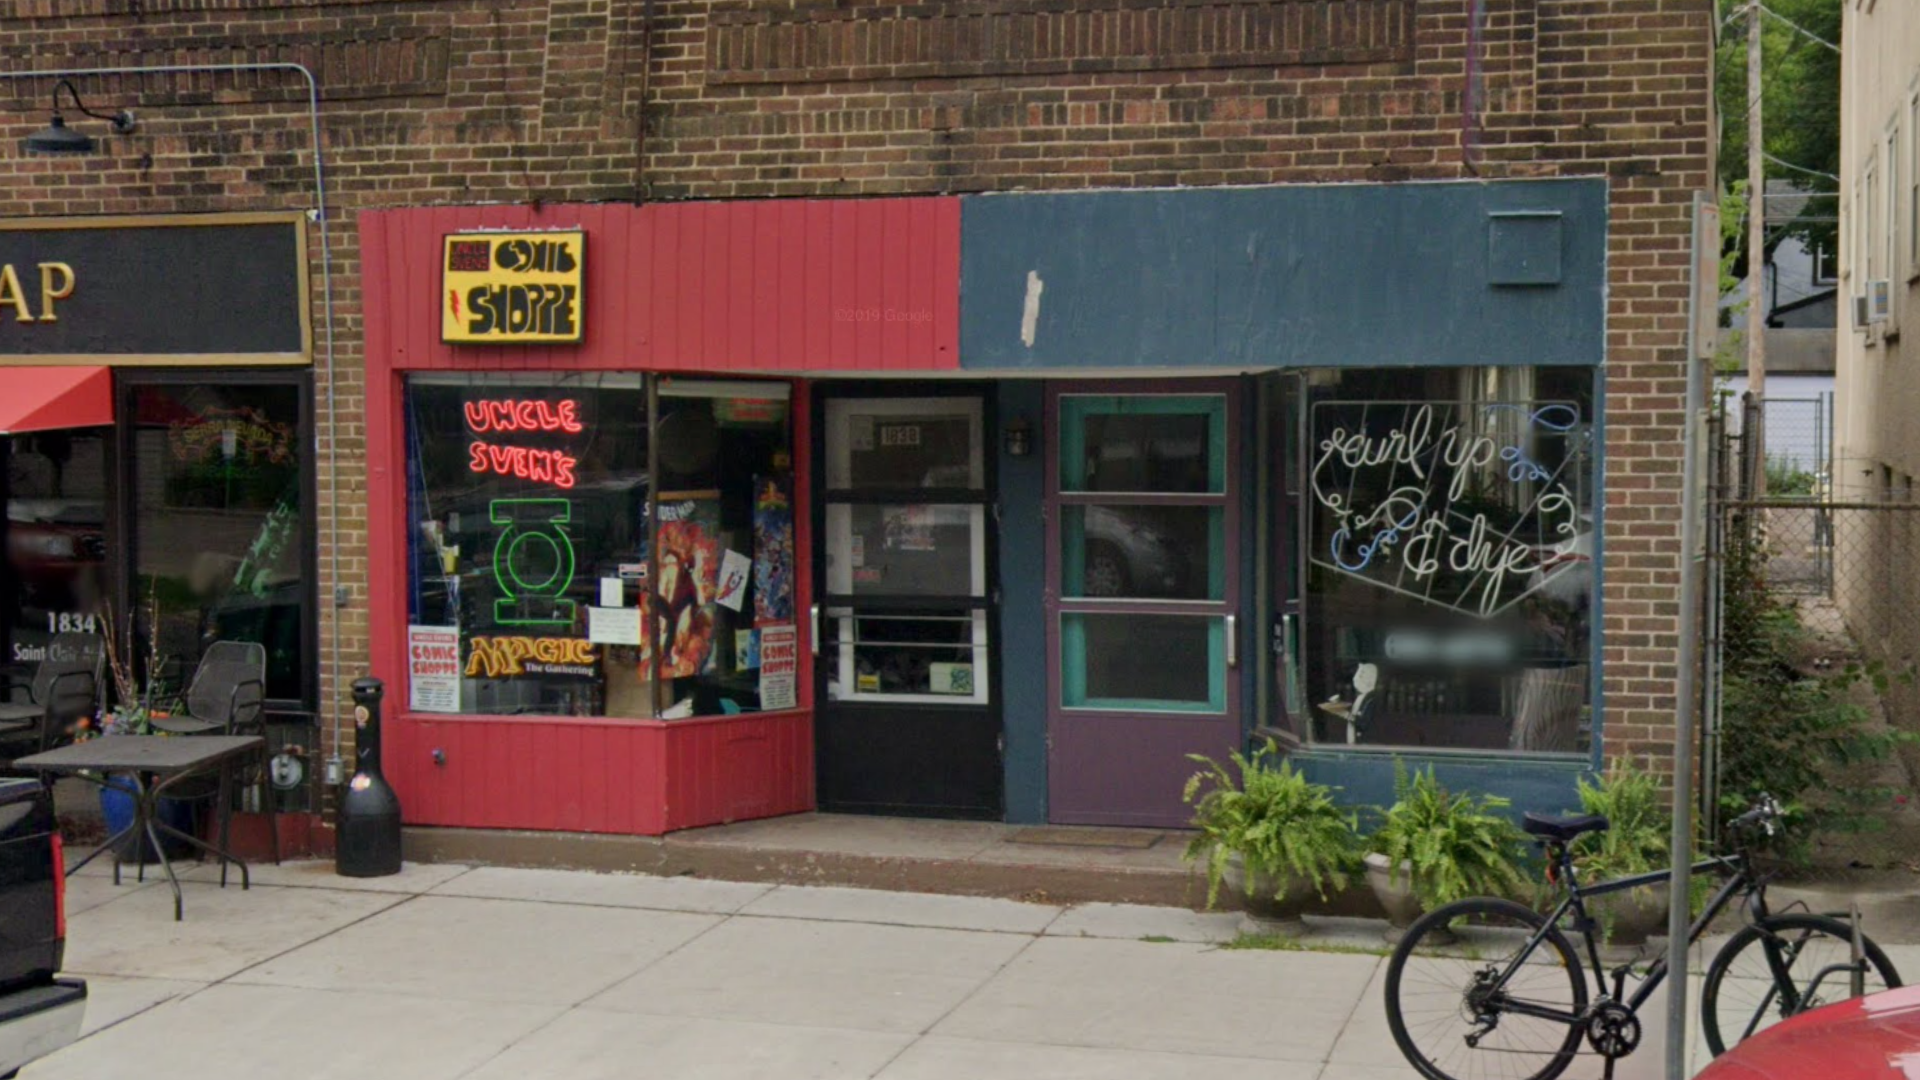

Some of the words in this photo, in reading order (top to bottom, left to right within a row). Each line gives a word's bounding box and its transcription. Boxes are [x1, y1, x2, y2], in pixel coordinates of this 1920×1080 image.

[495, 239, 577, 273] COMIC
[467, 283, 577, 335] SHOPPE
[464, 400, 582, 432] UNCLE
[469, 441, 577, 488] SVEN'S
[1444, 427, 1496, 501] up
[1449, 513, 1542, 618] dye
[47, 611, 96, 634] 1834
[13, 642, 46, 661] Saint
[412, 645, 458, 660] COMIC
[412, 660, 458, 675] SHOPPE
[464, 636, 595, 678] MAGIC
[763, 643, 796, 660] COMIC
[525, 662, 543, 673] The
[545, 664, 594, 677] Gathering
